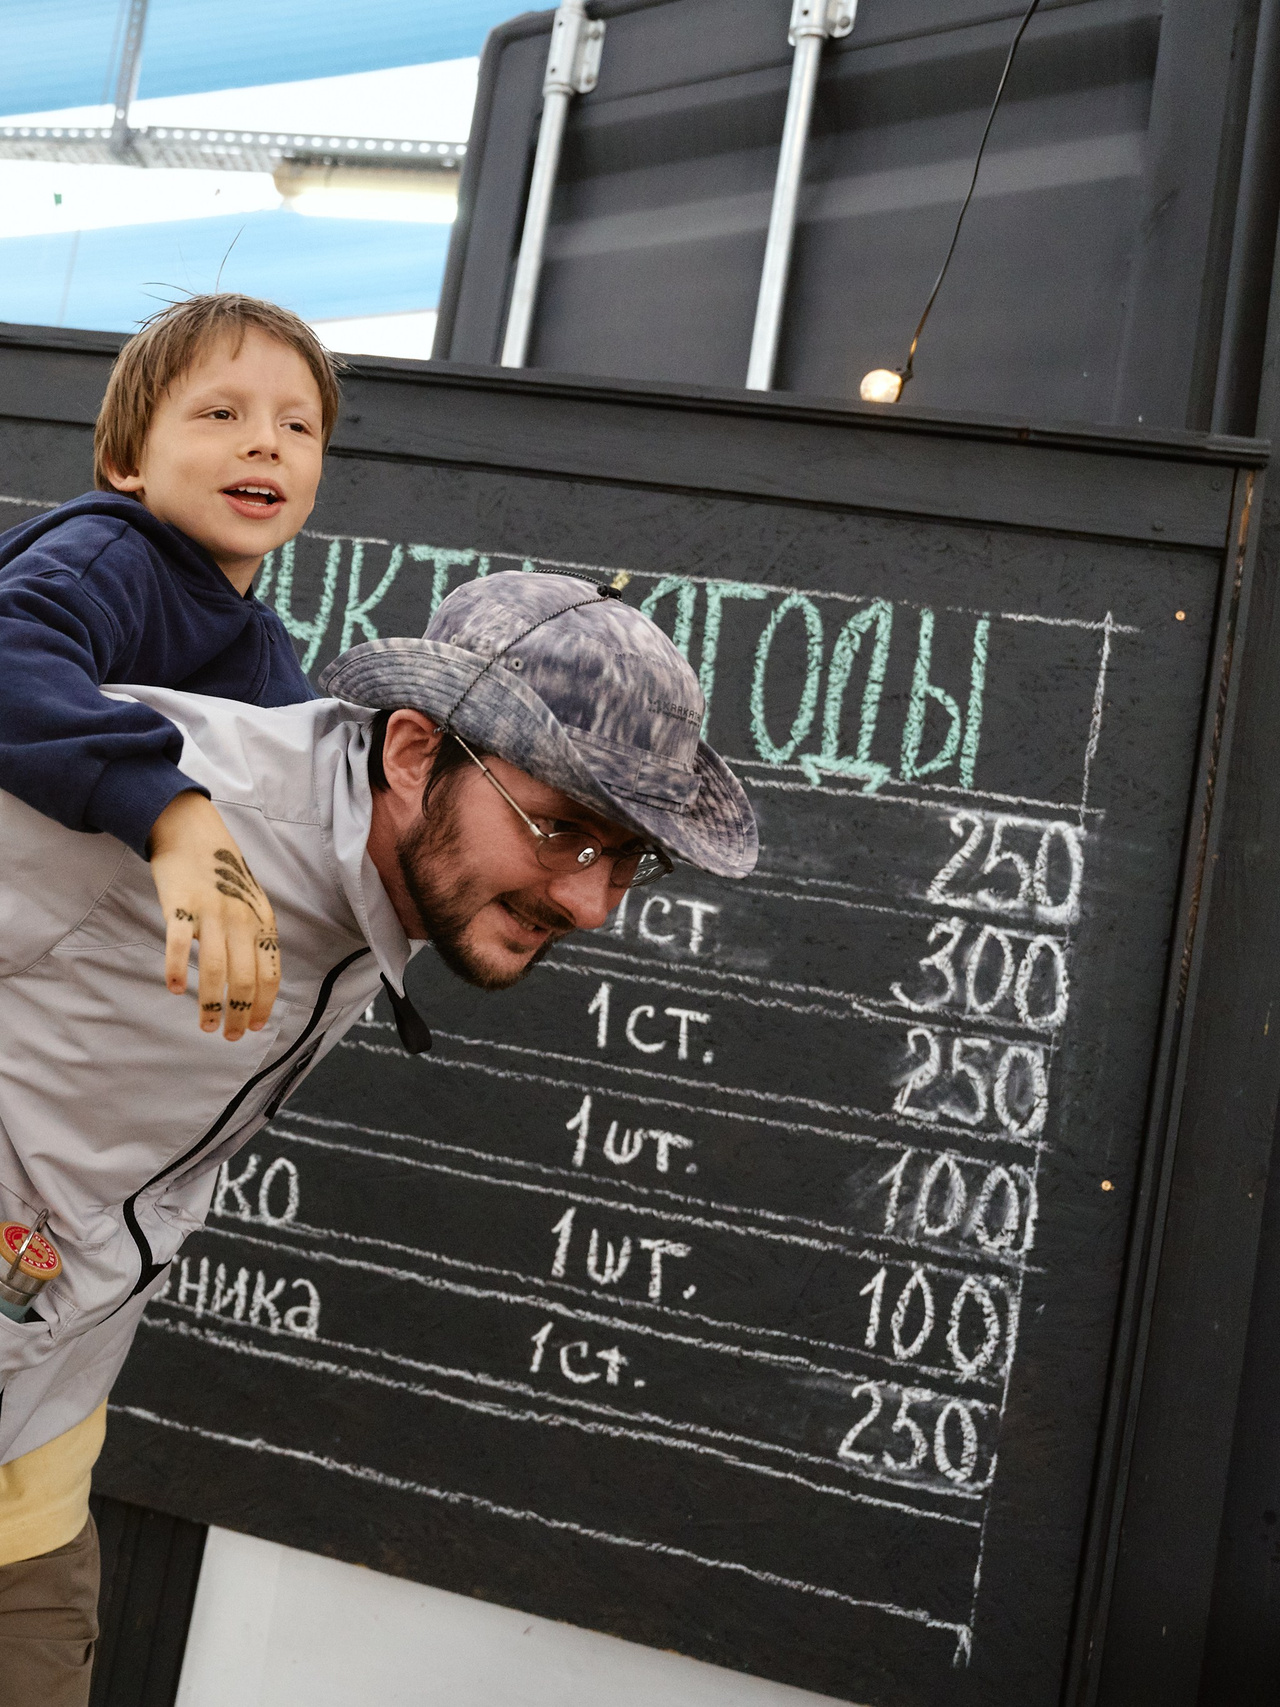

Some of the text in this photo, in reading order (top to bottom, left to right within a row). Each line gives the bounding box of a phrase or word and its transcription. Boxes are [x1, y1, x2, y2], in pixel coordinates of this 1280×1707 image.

[639, 574, 990, 793] ЯГОДЫ
[927, 811, 1083, 922] 250
[889, 917, 1070, 1030] 300
[891, 1027, 1049, 1138] 250
[878, 1148, 1022, 1251] 100
[859, 1262, 1000, 1382] 100
[837, 1381, 980, 1484] 250
